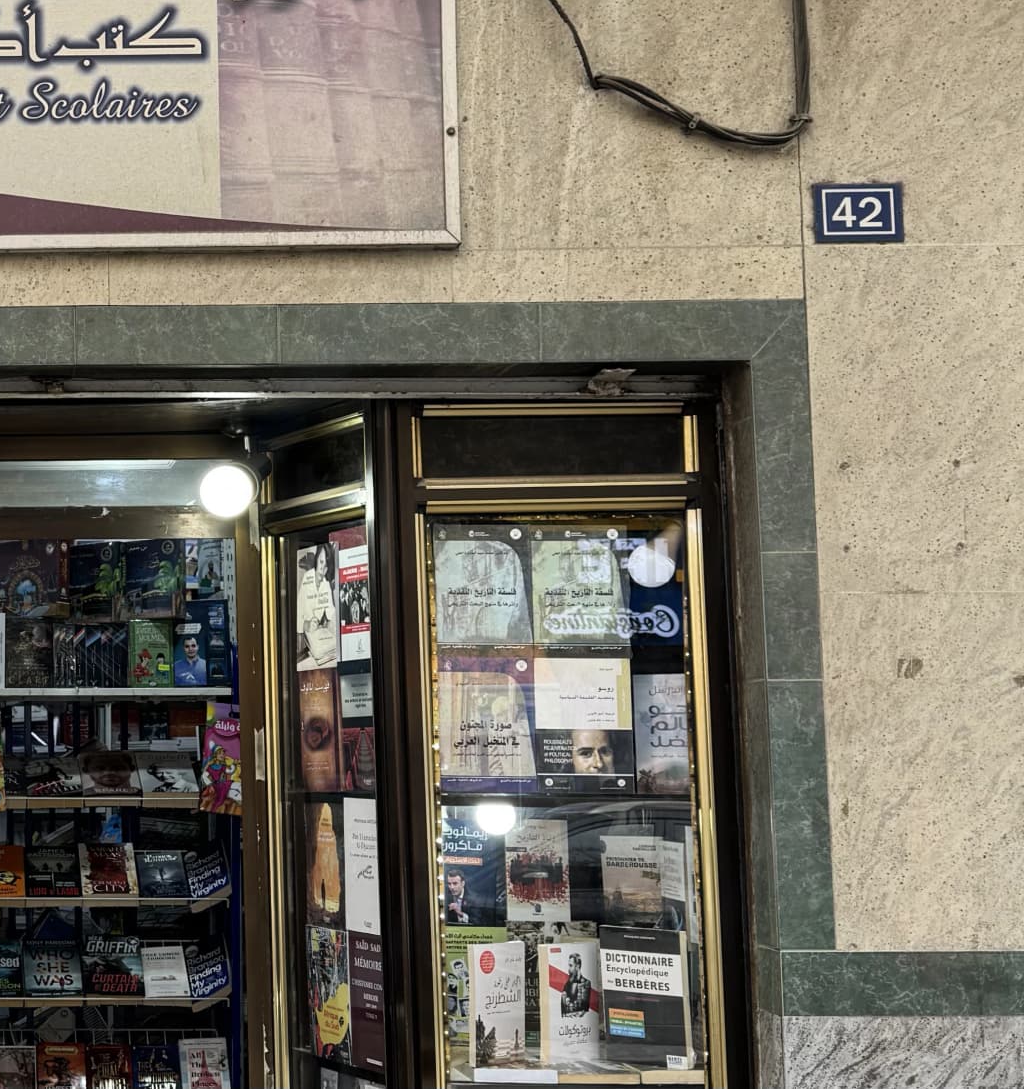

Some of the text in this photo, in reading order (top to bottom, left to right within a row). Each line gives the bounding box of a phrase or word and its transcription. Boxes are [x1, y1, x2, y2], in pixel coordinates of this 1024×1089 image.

[52, 11, 204, 68] كتب
[21, 78, 199, 121] Scolaires
[832, 197, 883, 227] 42
[188, 865, 221, 885] Finding
[86, 940, 138, 954] GRIFFIN
[369, 941, 381, 953] SAD
[31, 949, 74, 961] WHO
[605, 952, 674, 967] DICTIONNAIRE
[36, 962, 70, 973] SHE
[352, 956, 382, 971] MÉMOIRE
[606, 964, 669, 977] Encyclopédique
[33, 974, 74, 986] WAS
[189, 964, 222, 982] Finding
[190, 977, 208, 989] My
[191, 975, 227, 998] Virginity
[615, 977, 671, 992] BERBÈRES
[485, 988, 522, 1010] الشطرنج
